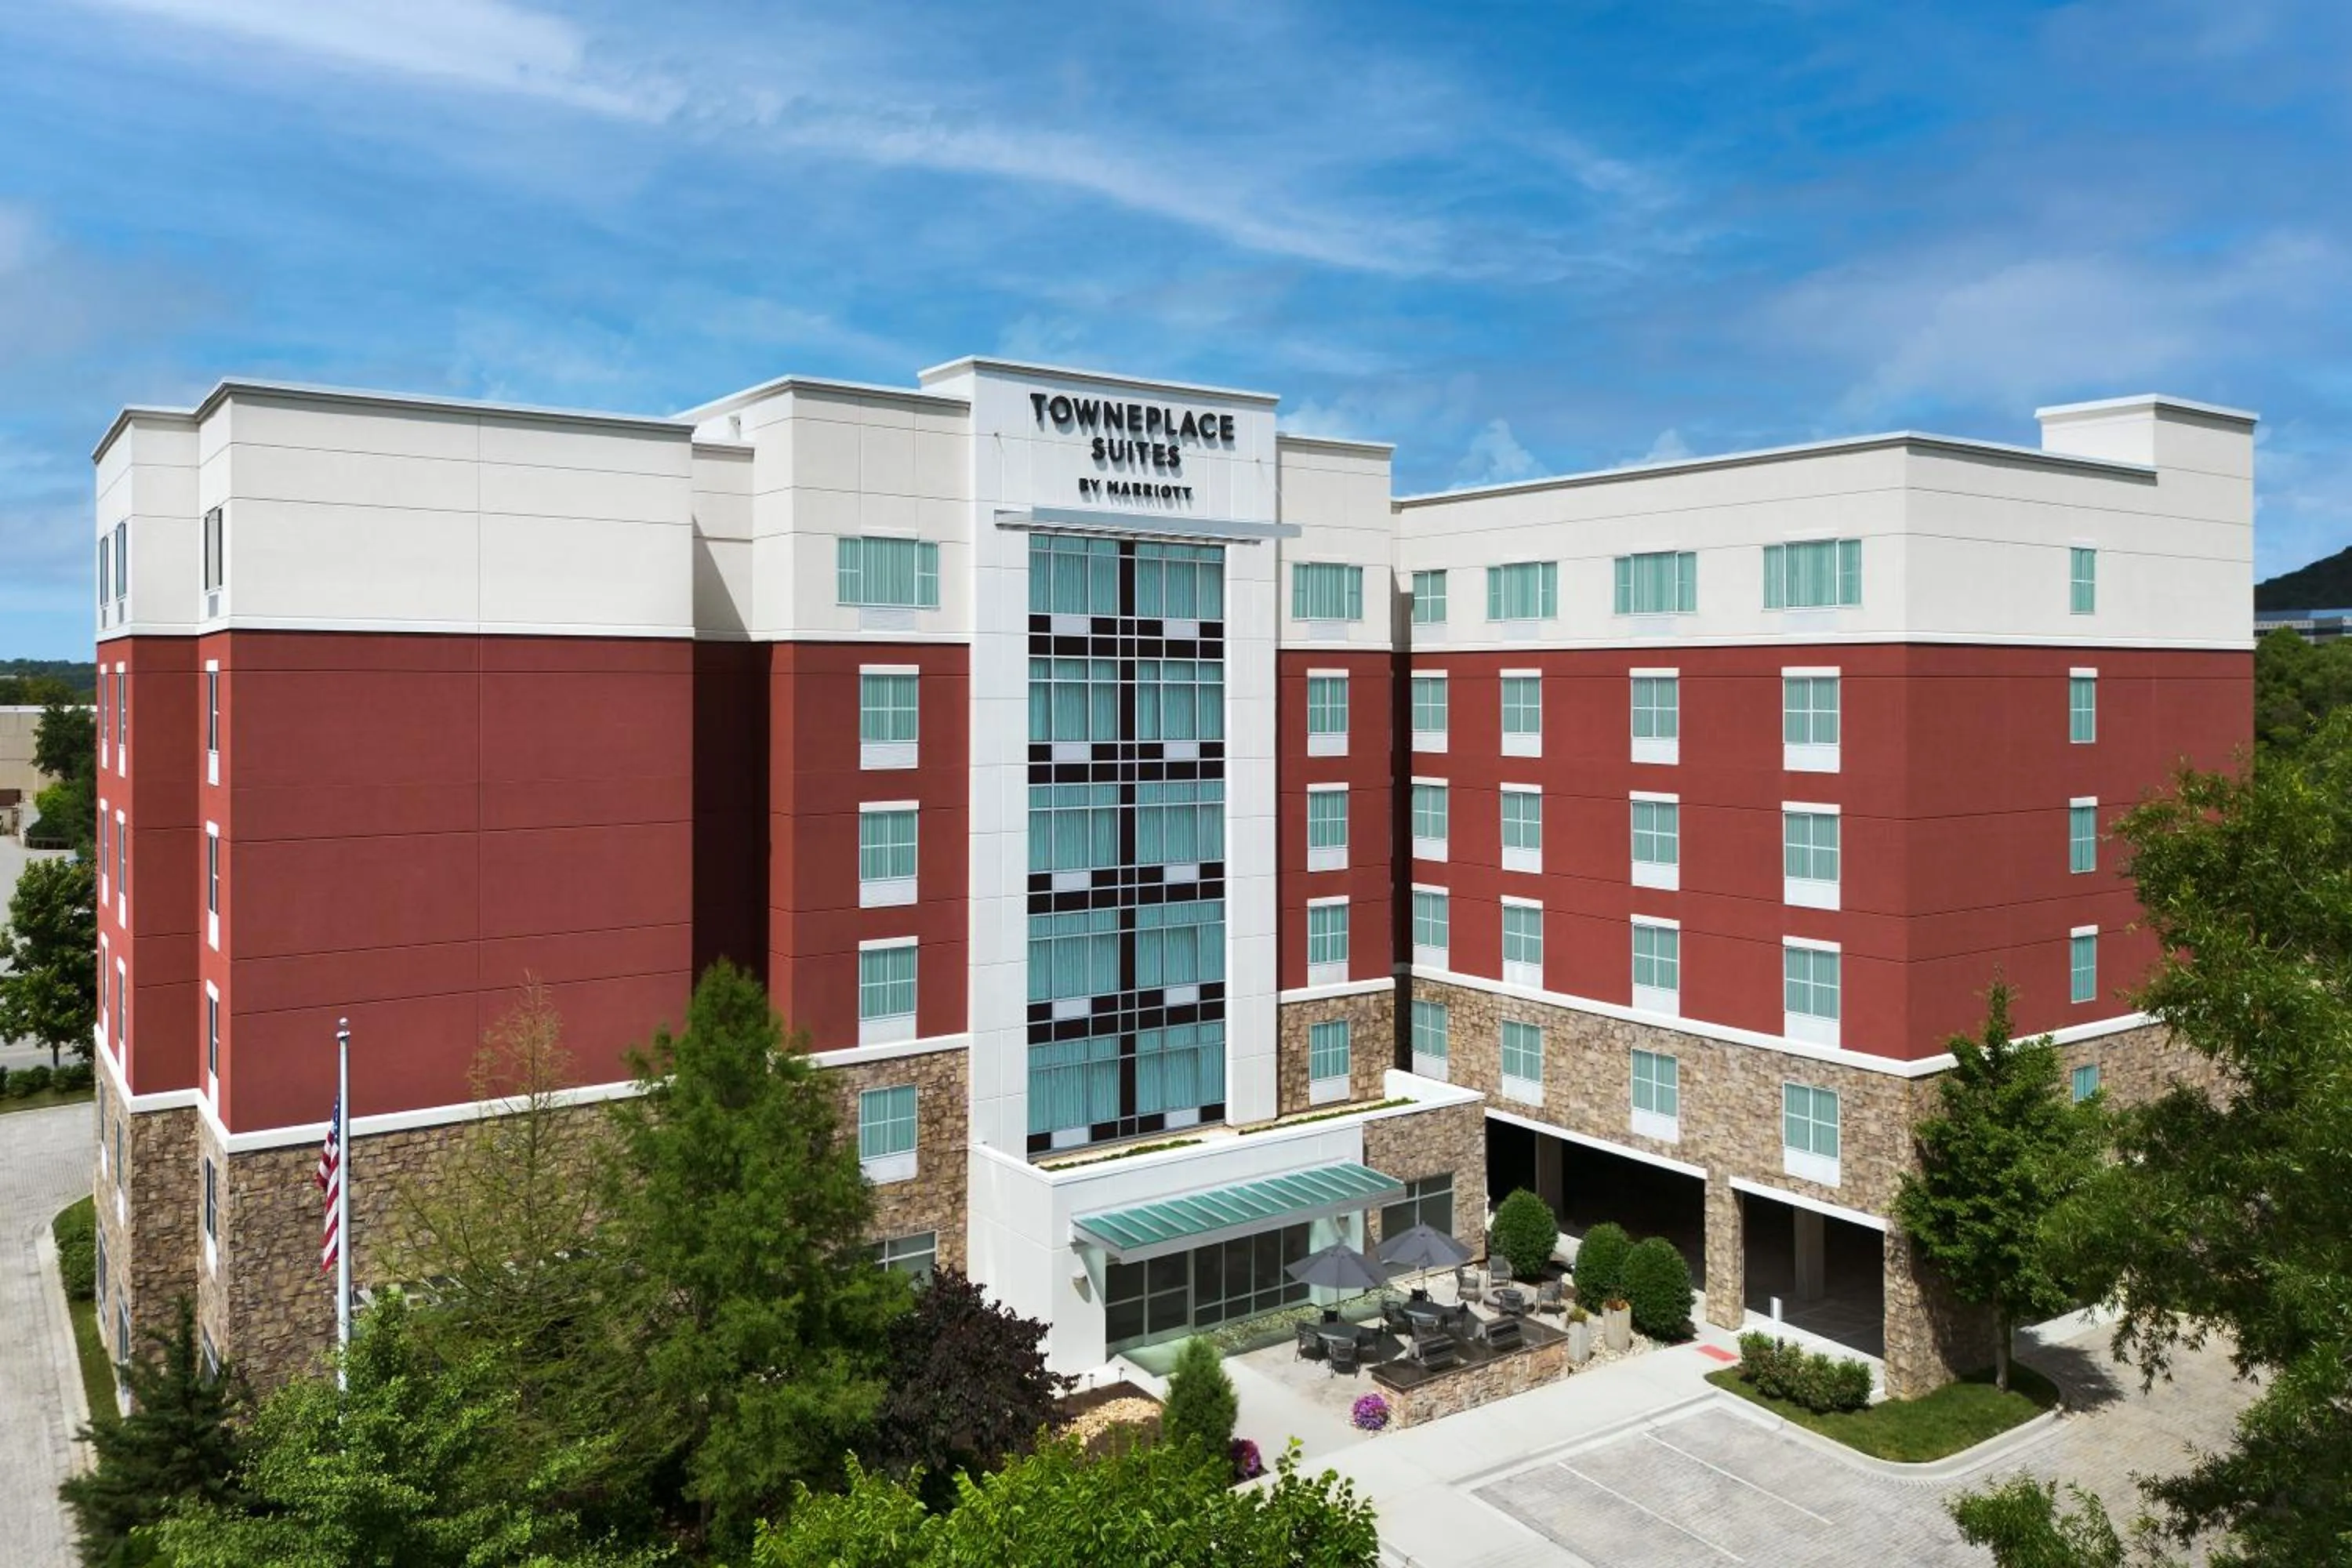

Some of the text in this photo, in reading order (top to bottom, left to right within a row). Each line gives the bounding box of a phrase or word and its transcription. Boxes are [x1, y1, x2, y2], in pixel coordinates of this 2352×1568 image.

[1029, 393, 1235, 441] TOWNEPLACE
[1091, 437, 1181, 468] SUITES
[1078, 477, 1192, 499] BY MARRIOTT
